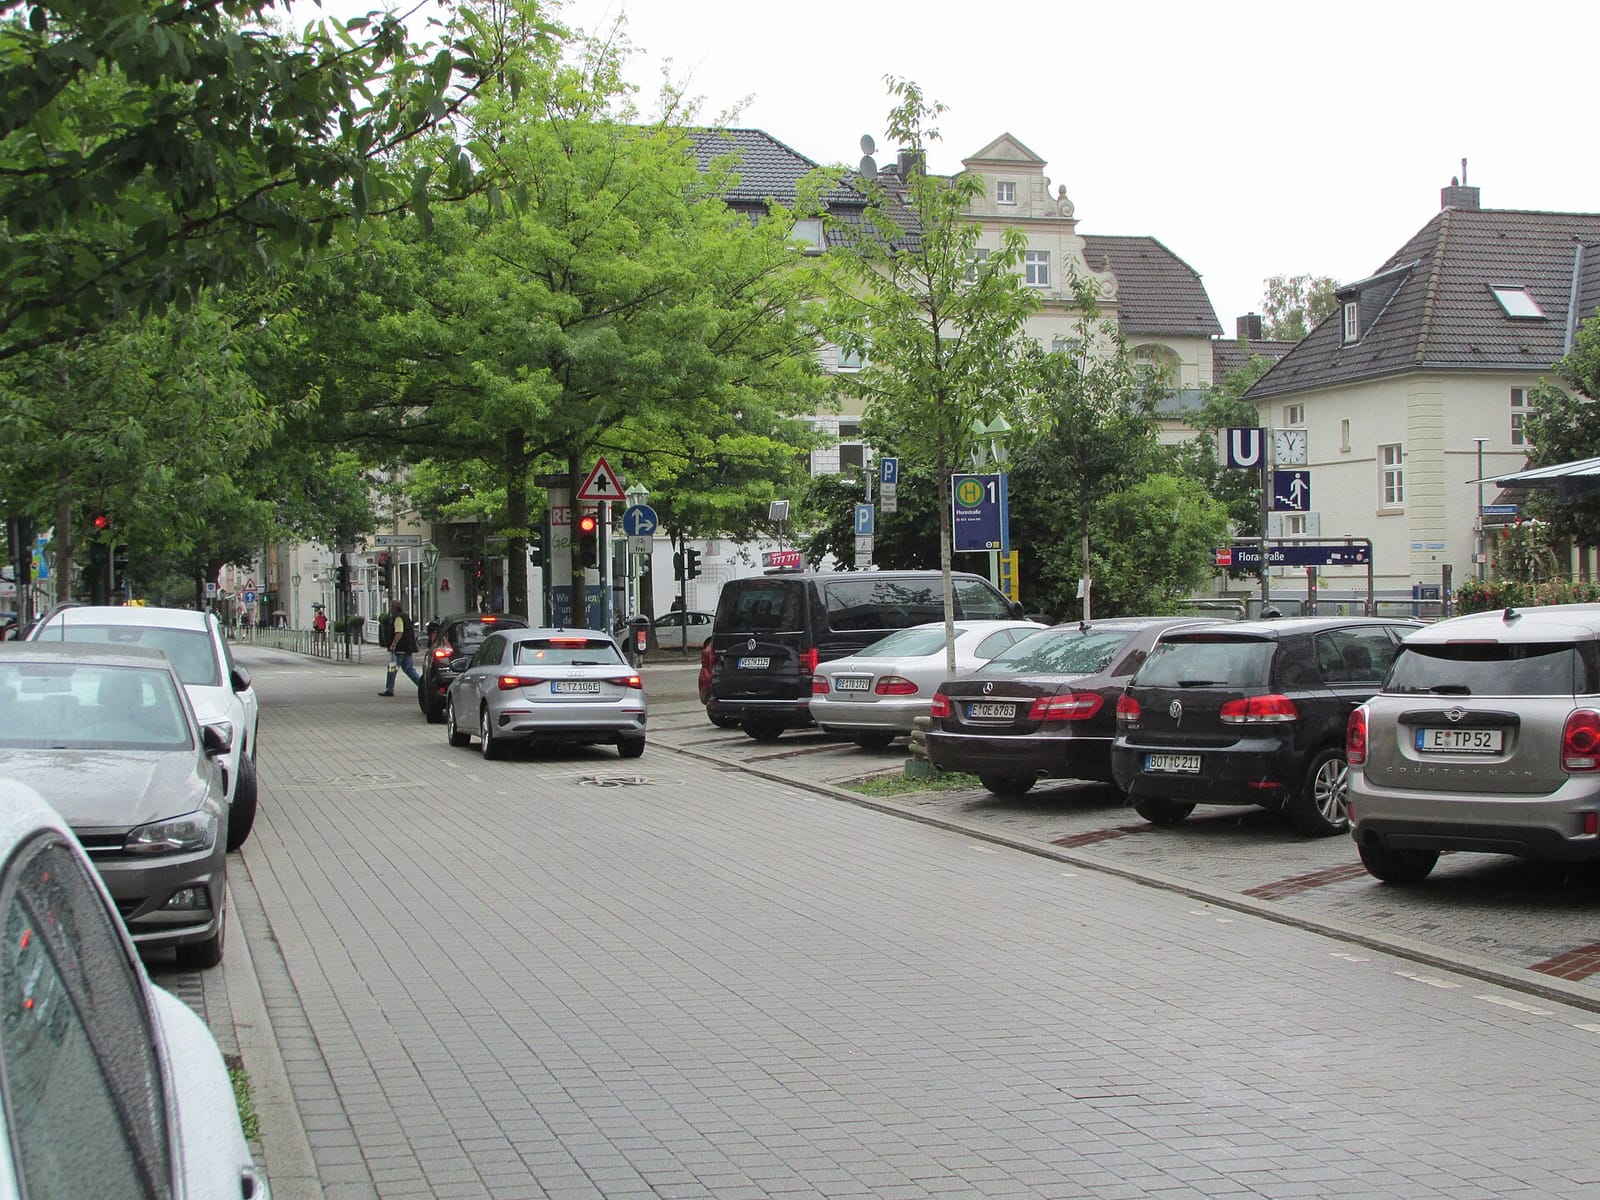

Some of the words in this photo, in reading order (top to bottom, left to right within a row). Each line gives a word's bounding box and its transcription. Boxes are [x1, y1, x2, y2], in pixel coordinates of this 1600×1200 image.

[1232, 429, 1260, 467] U
[986, 481, 997, 504] 1
[1434, 731, 1444, 746] E
[1453, 731, 1472, 747] TP
[1474, 732, 1492, 748] 52
[1387, 766, 1532, 776] COUNTRYMAN
